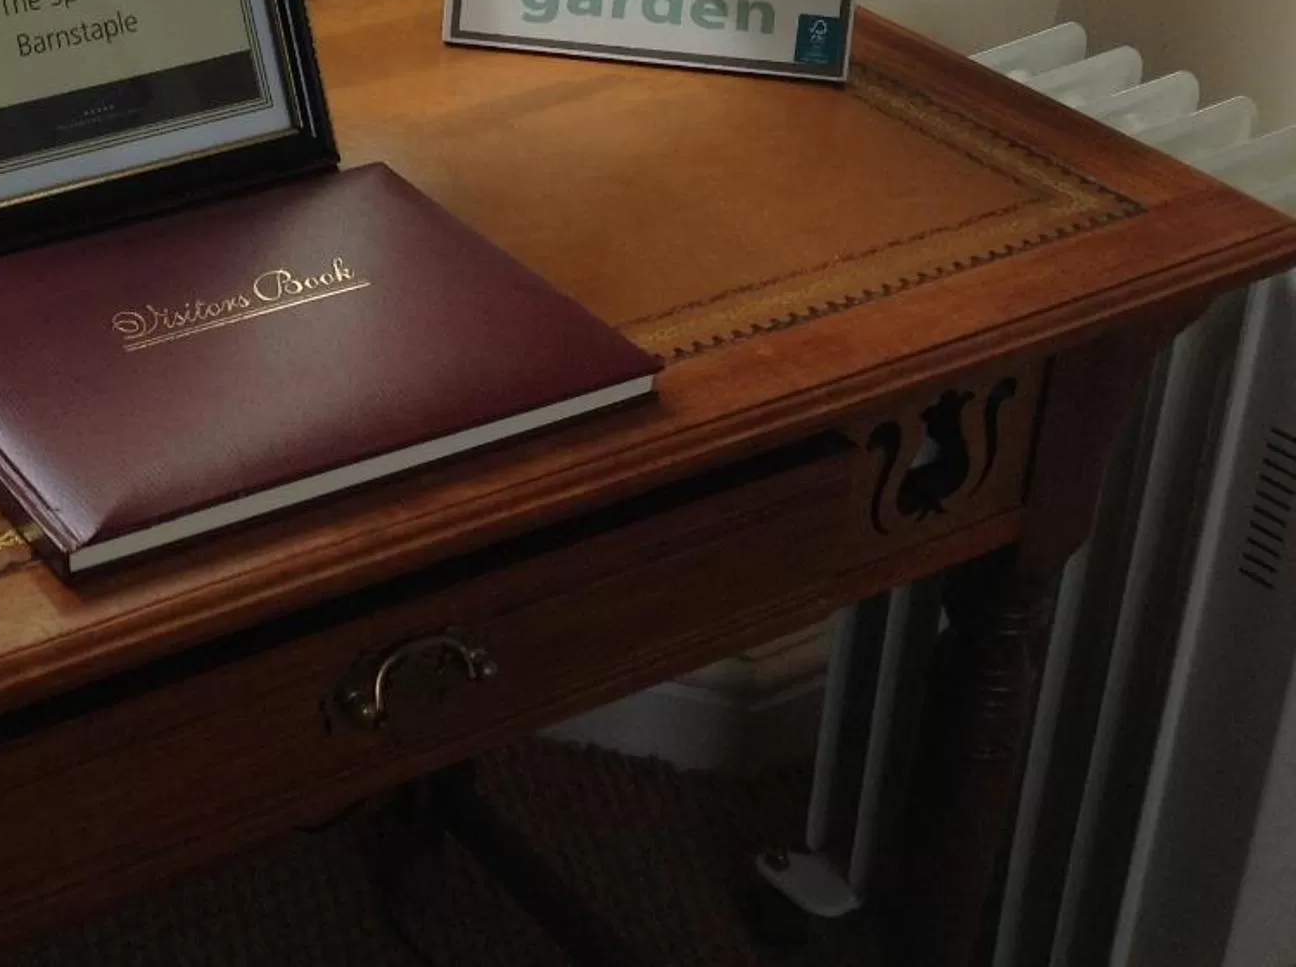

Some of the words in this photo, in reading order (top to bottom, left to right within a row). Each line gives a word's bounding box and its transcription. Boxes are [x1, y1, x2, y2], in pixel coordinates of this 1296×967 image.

[16, 11, 138, 58] Barnstaple
[111, 293, 251, 340] Visitors
[253, 256, 355, 301] Book
